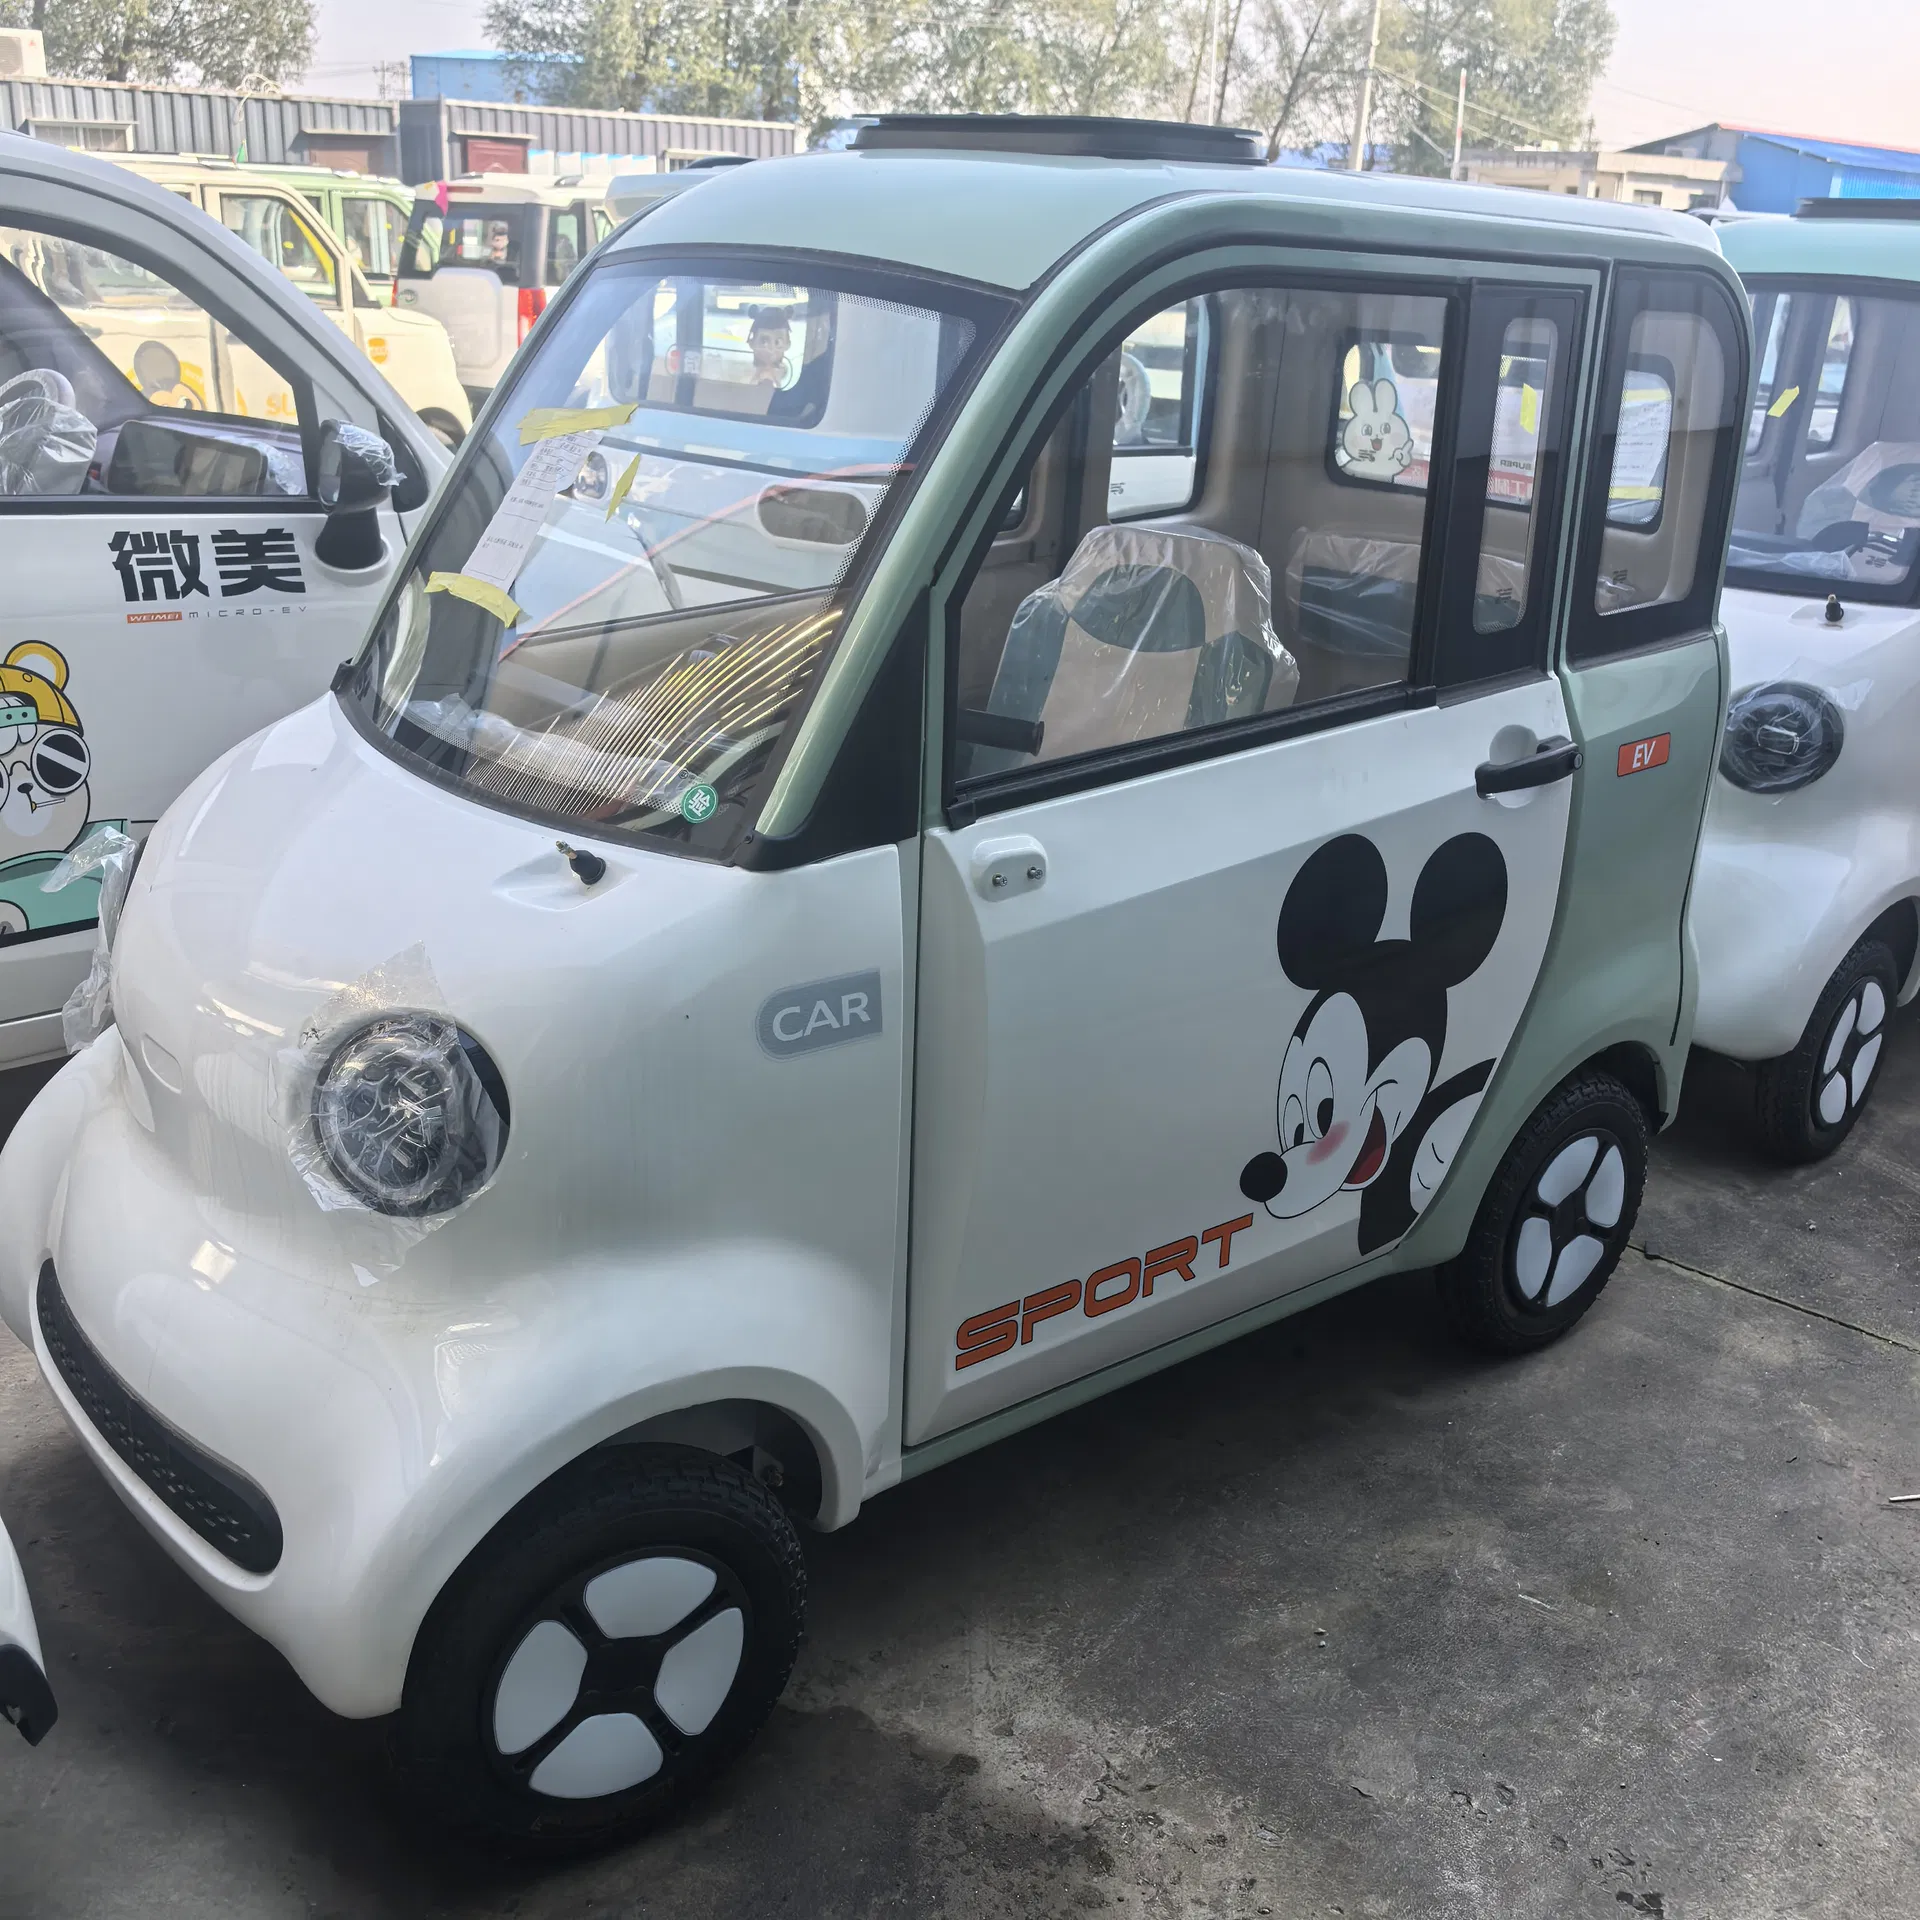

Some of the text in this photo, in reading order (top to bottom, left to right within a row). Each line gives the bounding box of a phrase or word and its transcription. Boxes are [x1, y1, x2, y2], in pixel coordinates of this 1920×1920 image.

[107, 528, 306, 602] 微美
[129, 613, 180, 622] WEIMEI
[1632, 740, 1656, 769] EV
[688, 788, 711, 817] 验
[772, 991, 871, 1041] CAR
[955, 1212, 1254, 1371] SPORT
